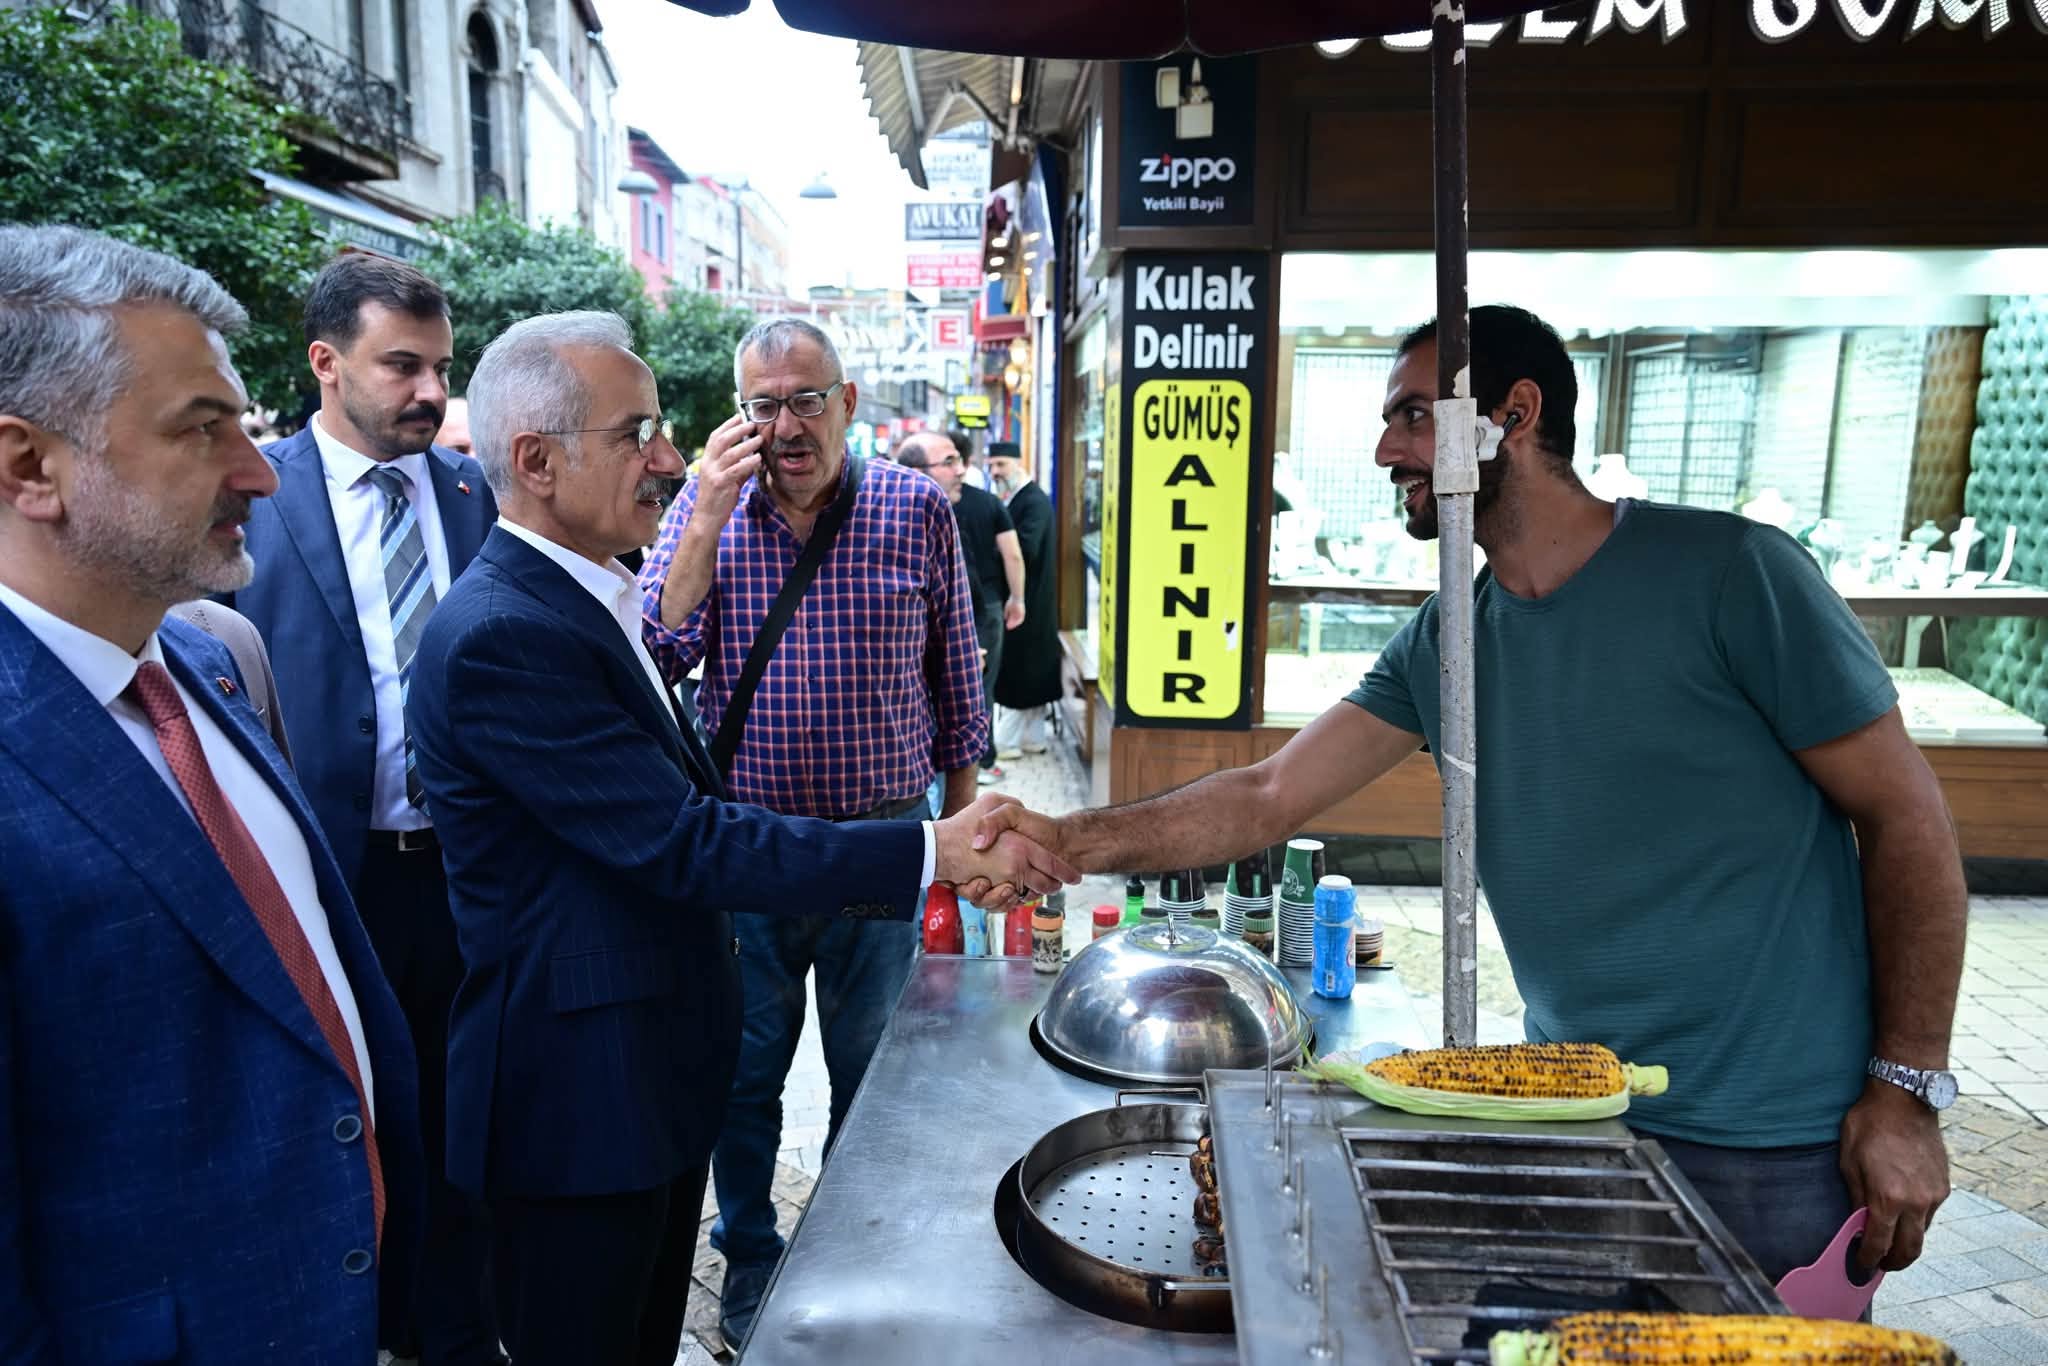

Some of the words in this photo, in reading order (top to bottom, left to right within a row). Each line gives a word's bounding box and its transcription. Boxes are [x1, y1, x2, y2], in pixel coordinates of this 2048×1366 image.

[1140, 153, 1236, 188] zippo
[911, 205, 978, 228] AVUKAT
[1143, 197, 1187, 211] Yetkili
[1190, 197, 1225, 213] Bayii
[1135, 266, 1255, 311] Kulak
[939, 320, 957, 344] E
[1134, 324, 1254, 370] Delinir
[1143, 384, 1241, 448] GÜMÜŞ
[1161, 454, 1216, 704] ALINIR
